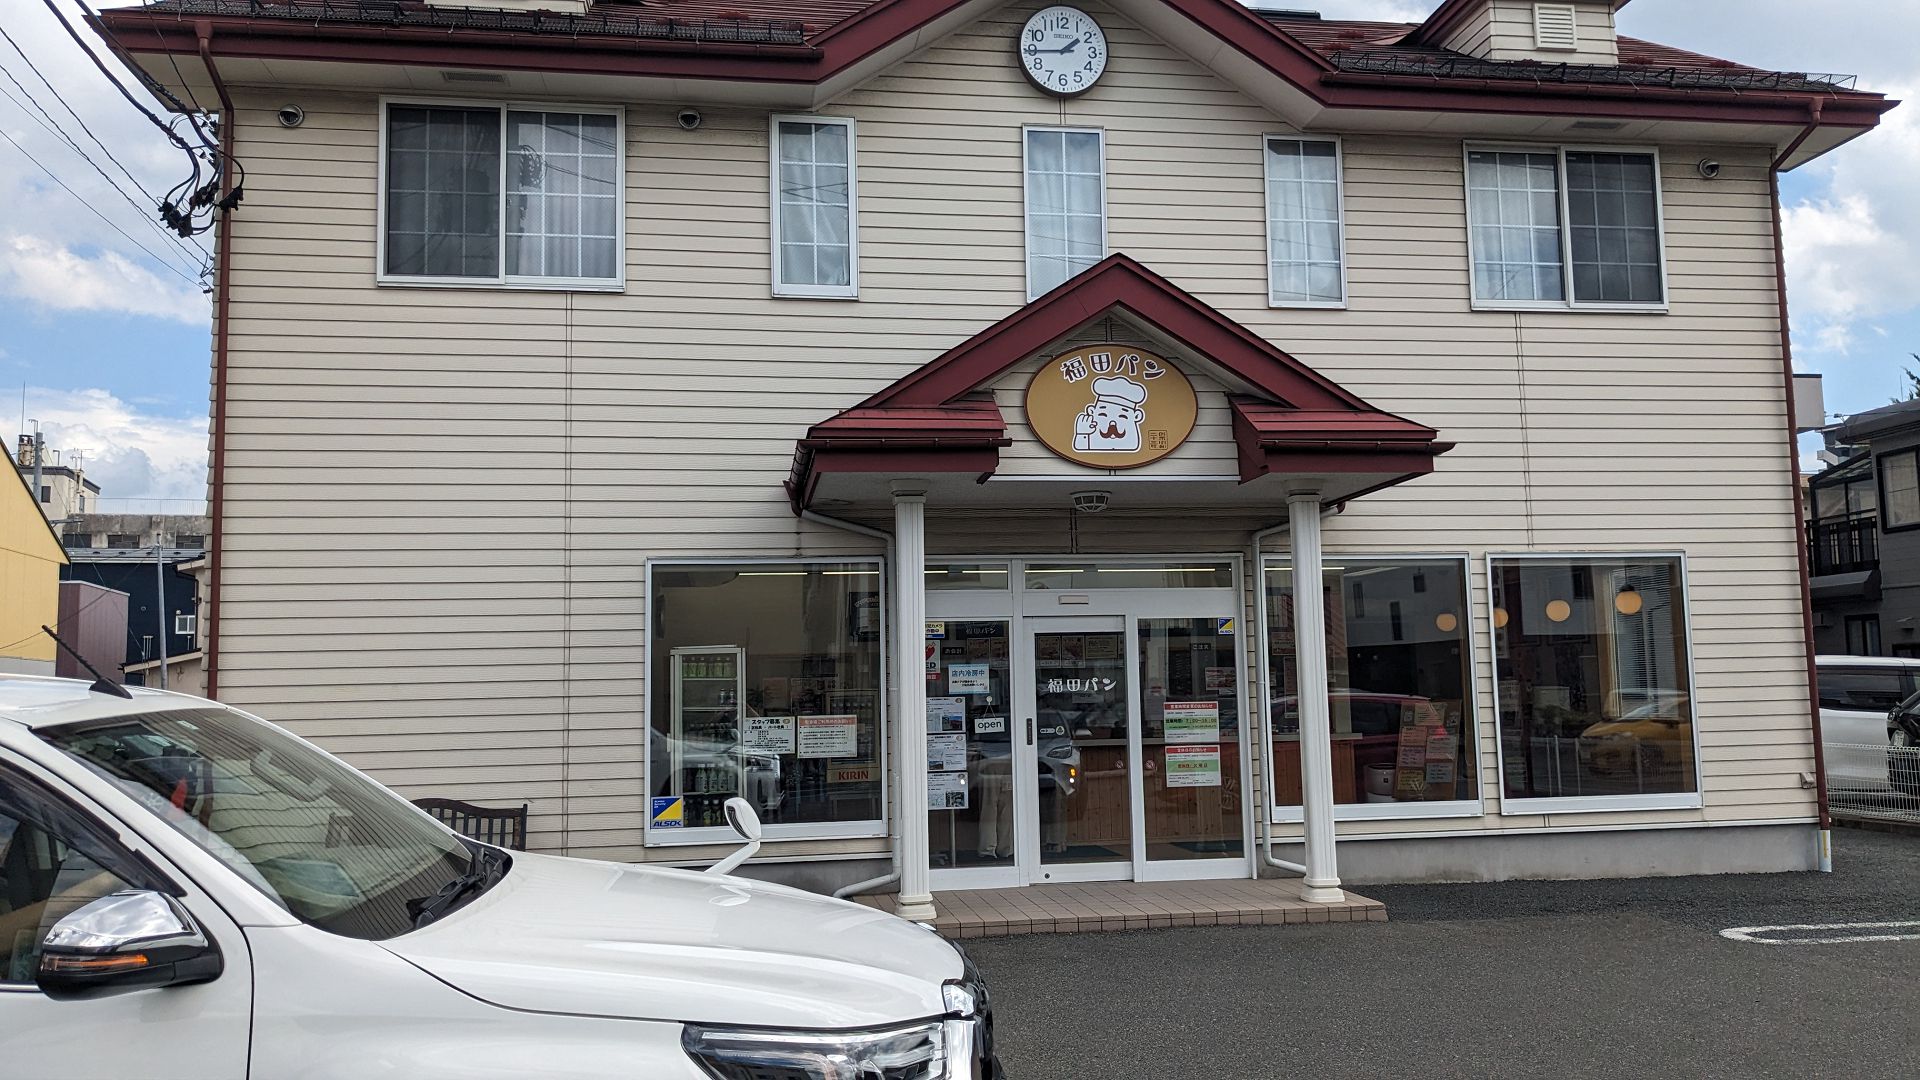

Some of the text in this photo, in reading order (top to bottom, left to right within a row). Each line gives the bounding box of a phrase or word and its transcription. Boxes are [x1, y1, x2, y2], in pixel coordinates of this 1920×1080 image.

[1044, 19, 1054, 32] 11
[1056, 16, 1070, 30] 12
[1031, 29, 1044, 42] 10
[1083, 31, 1093, 44] 2
[1027, 44, 1038, 57] 9
[1087, 46, 1098, 59] 3
[1033, 57, 1043, 71] 8
[1083, 60, 1094, 73] 4
[1045, 69, 1054, 82] 7
[1058, 73, 1068, 87] 6
[1073, 70, 1083, 84] 5
[1061, 352, 1166, 383] 福田パン
[951, 669, 985, 678] 店内冷房中
[1047, 677, 1117, 693] 福田パン
[977, 720, 1002, 730] open
[838, 771, 869, 781] KIRIN
